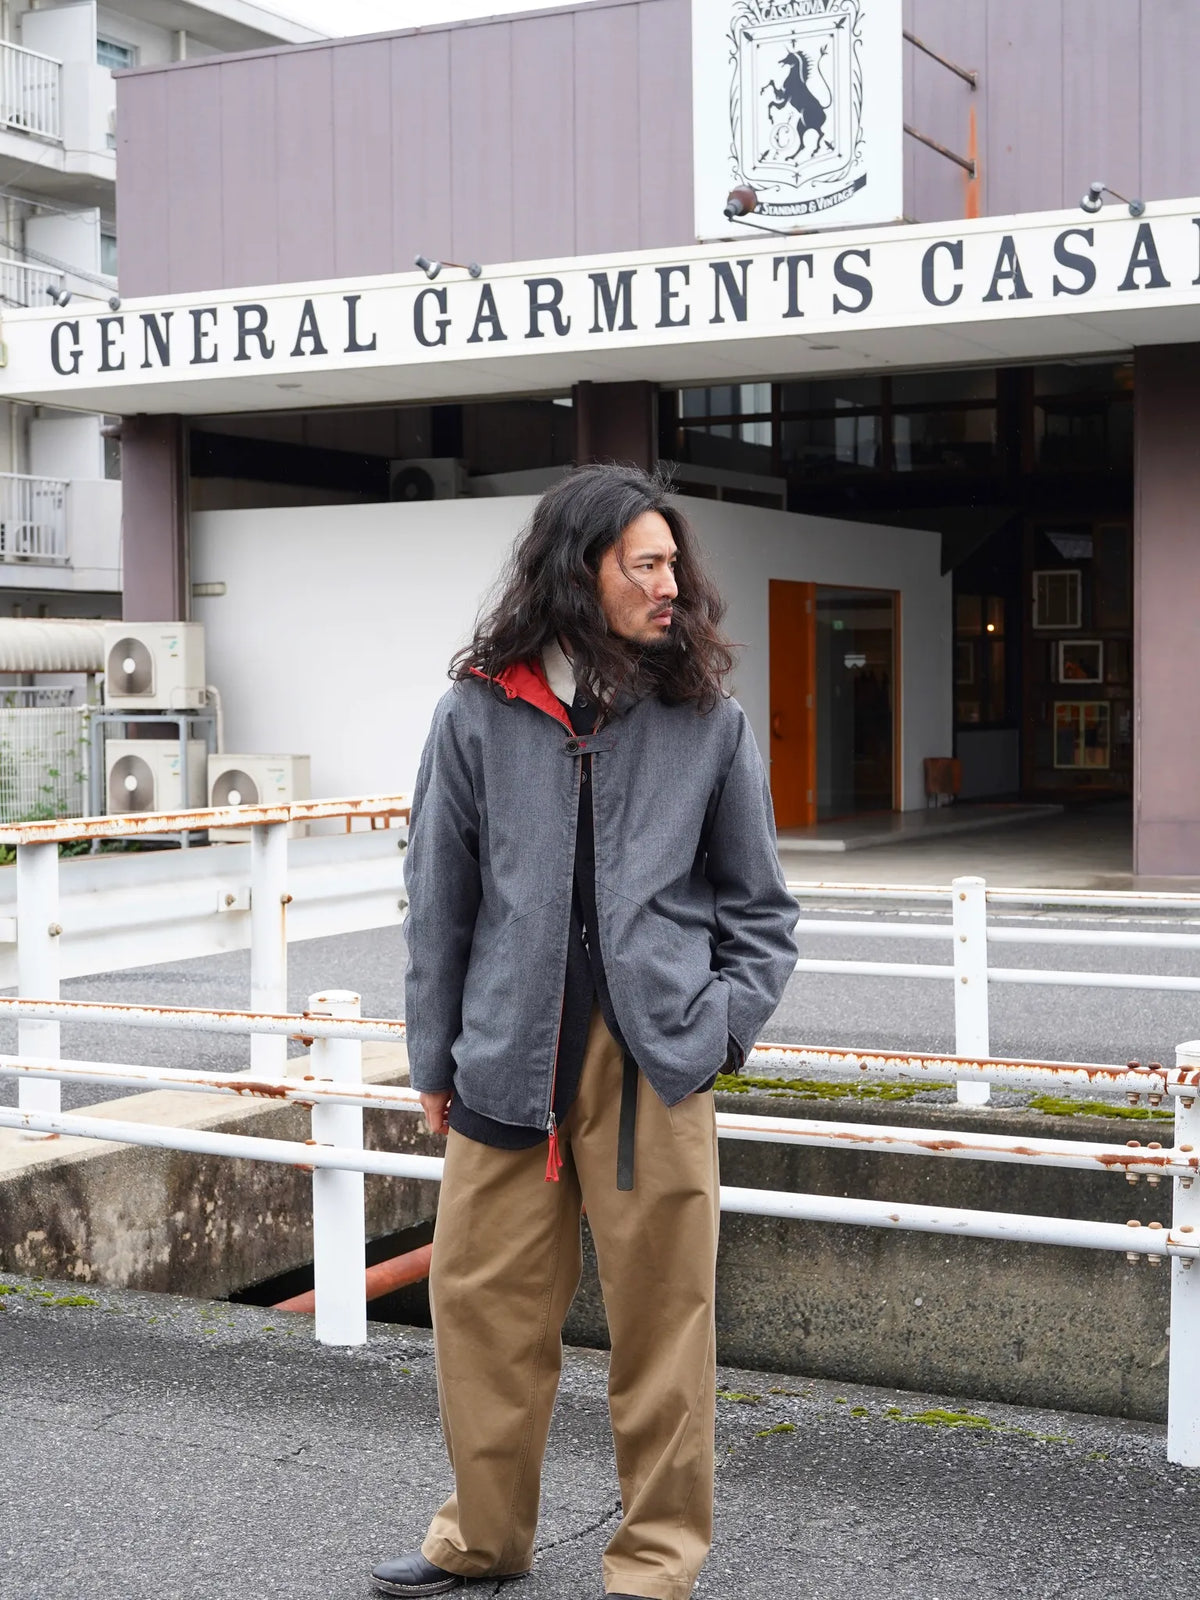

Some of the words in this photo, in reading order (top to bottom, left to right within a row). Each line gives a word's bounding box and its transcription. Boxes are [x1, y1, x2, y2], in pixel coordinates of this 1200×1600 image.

[50, 294, 377, 376] GENERAL
[413, 248, 874, 348] GARMENTS
[921, 218, 1200, 307] CASA
